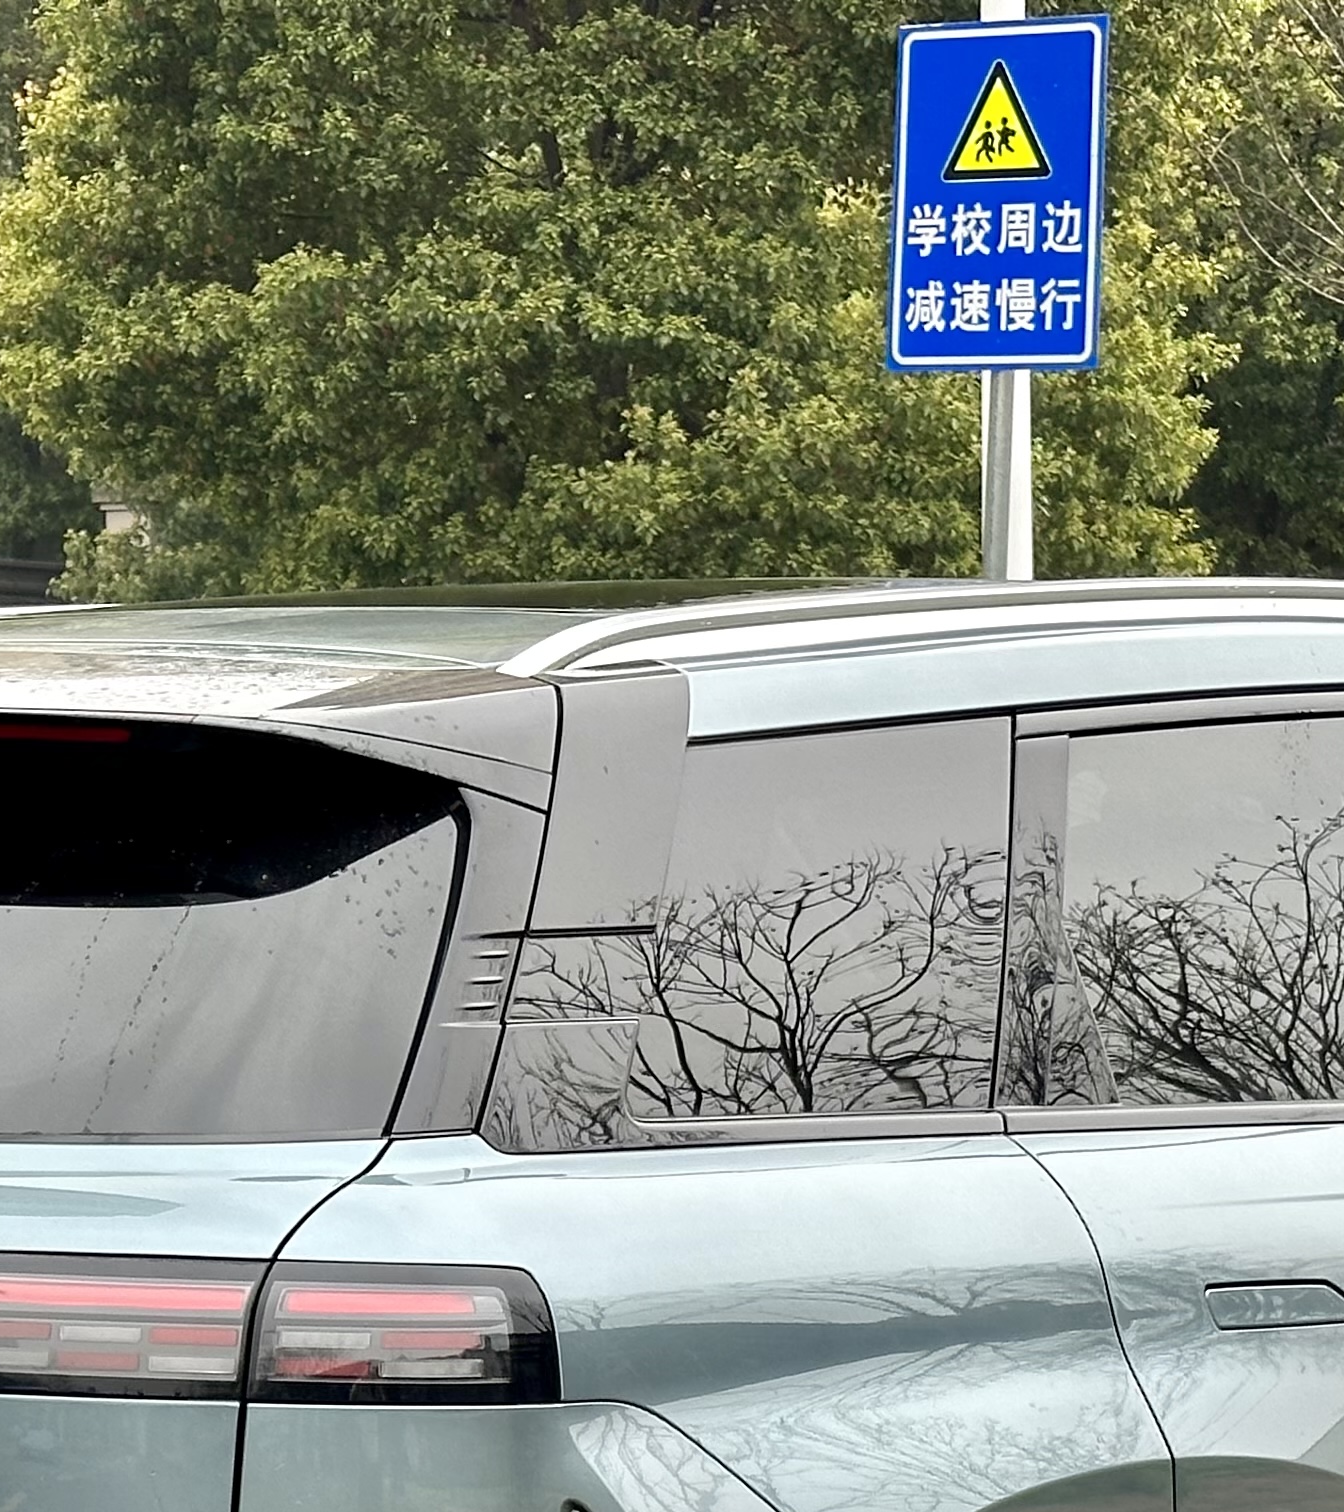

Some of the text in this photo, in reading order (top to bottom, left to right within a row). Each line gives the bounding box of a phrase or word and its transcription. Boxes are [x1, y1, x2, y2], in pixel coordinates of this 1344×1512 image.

[907, 199, 1083, 257] 学校周边
[905, 278, 1082, 332] 减速慢行
